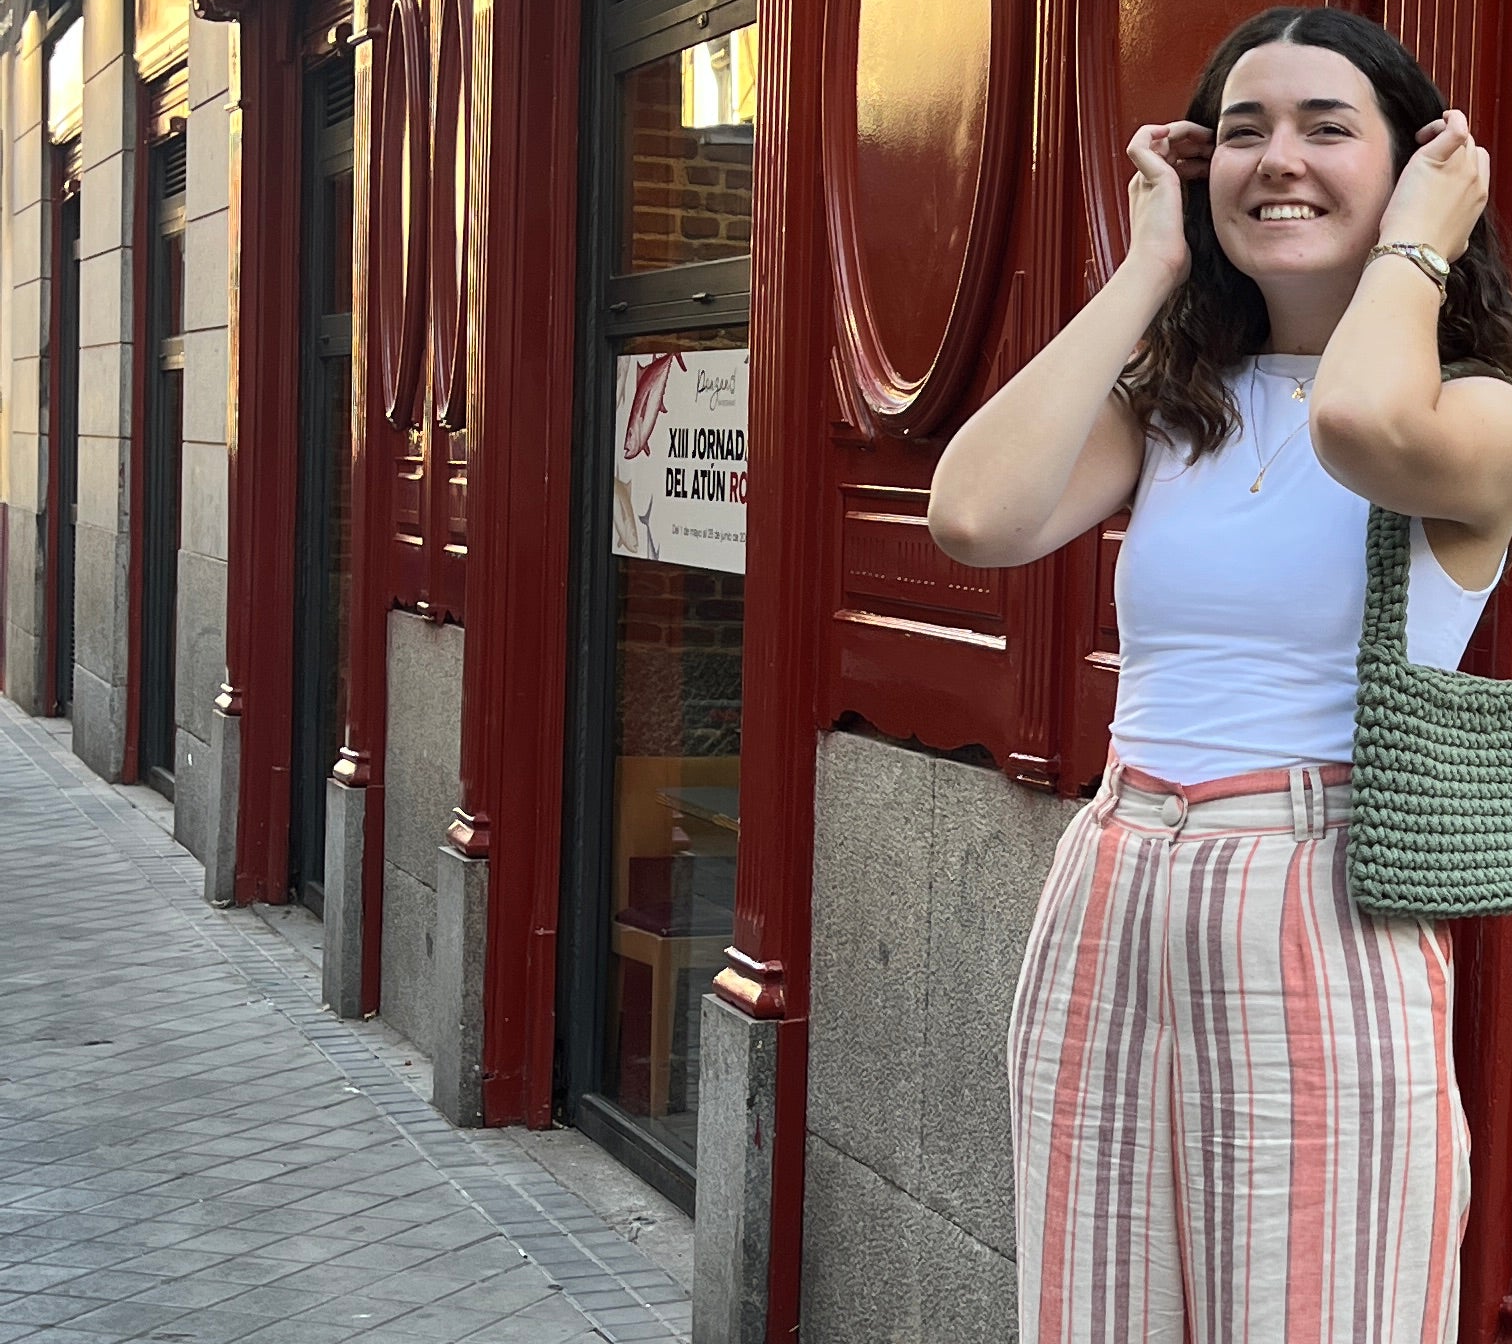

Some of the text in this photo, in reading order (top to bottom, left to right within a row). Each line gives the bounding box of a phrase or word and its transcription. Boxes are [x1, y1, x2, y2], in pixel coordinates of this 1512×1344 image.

[668, 428, 747, 461] XIII JORNAD
[666, 468, 688, 498] DEL
[691, 463, 725, 502] ATÚN
